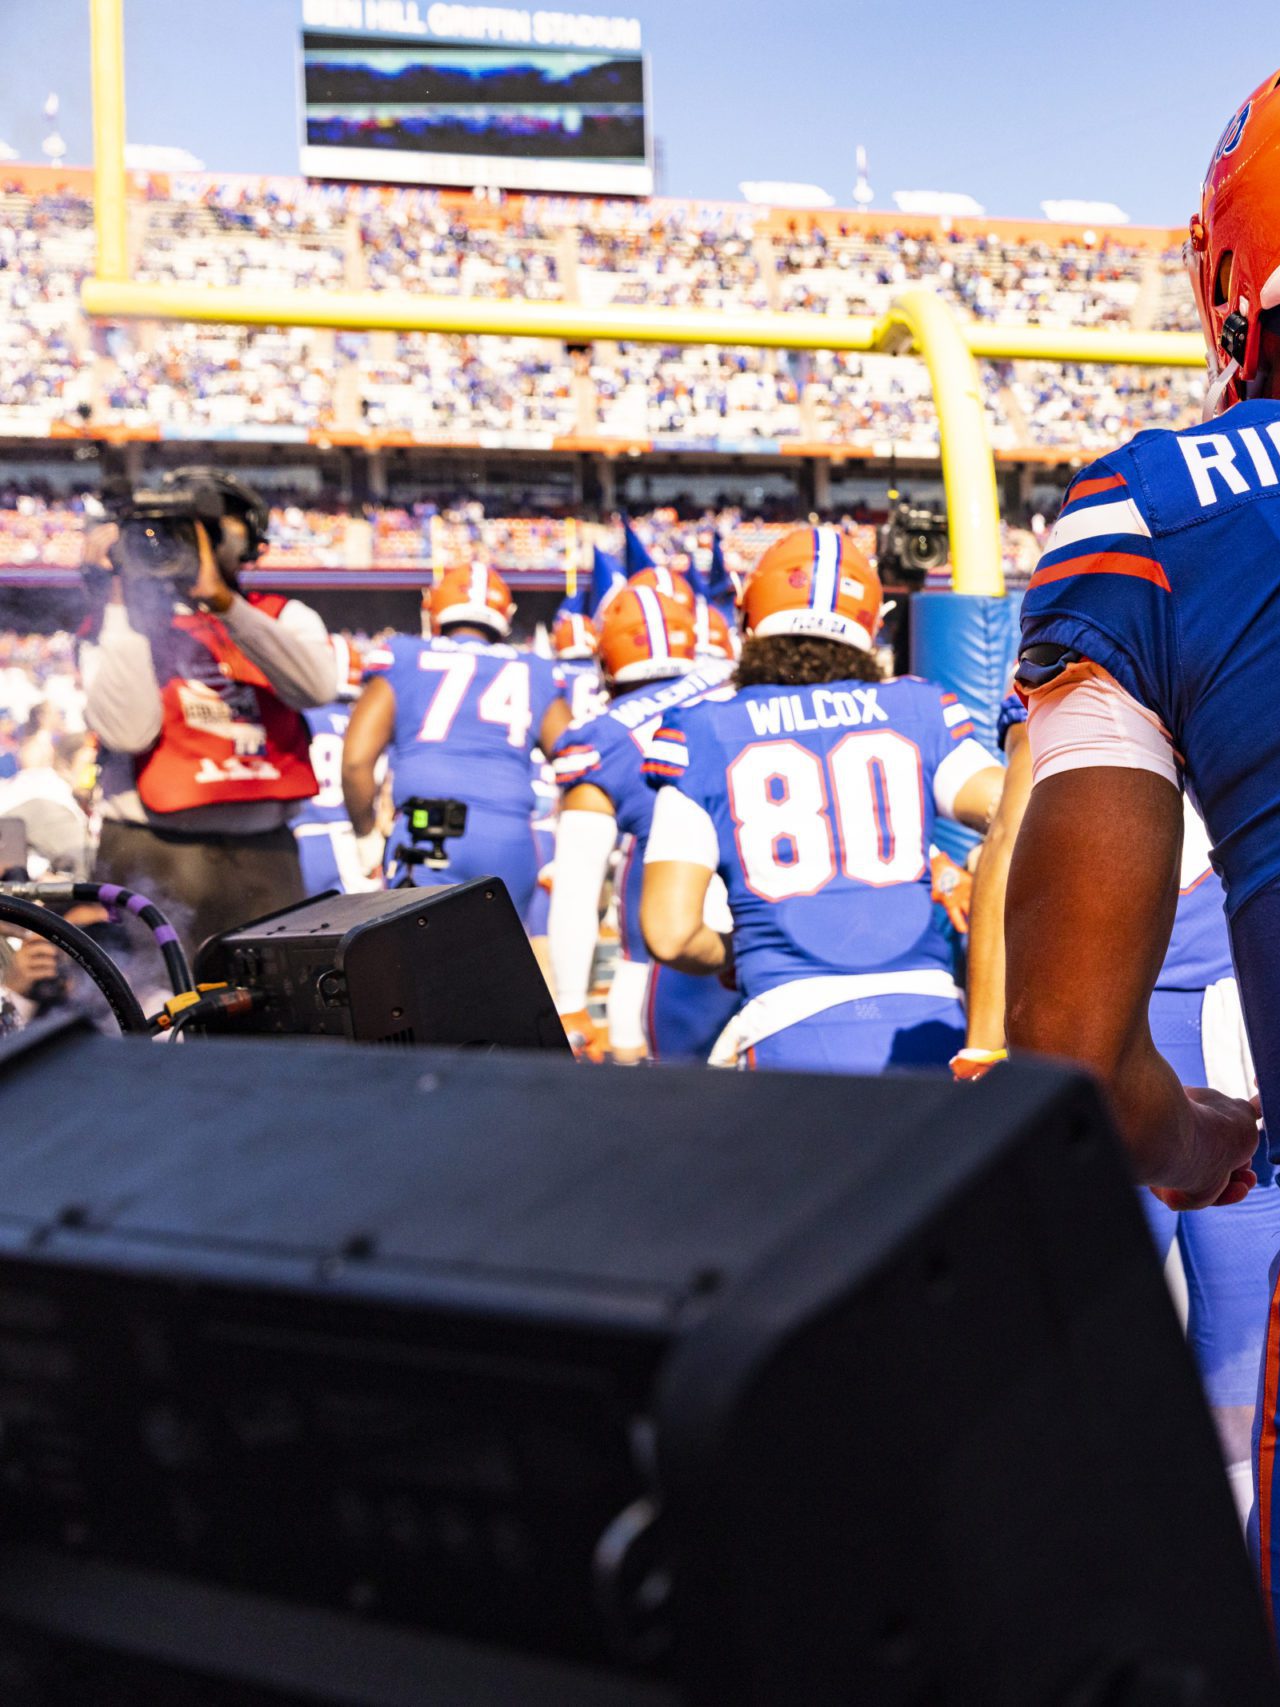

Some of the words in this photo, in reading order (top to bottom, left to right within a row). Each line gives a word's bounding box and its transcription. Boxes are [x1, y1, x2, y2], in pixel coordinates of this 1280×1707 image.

[365, 0, 427, 34] HILL
[427, 2, 532, 42] GRIFFIN
[532, 11, 641, 50] STADIUM
[416, 651, 533, 748] 74
[745, 687, 889, 736] WILCOX
[727, 728, 926, 902] 80
